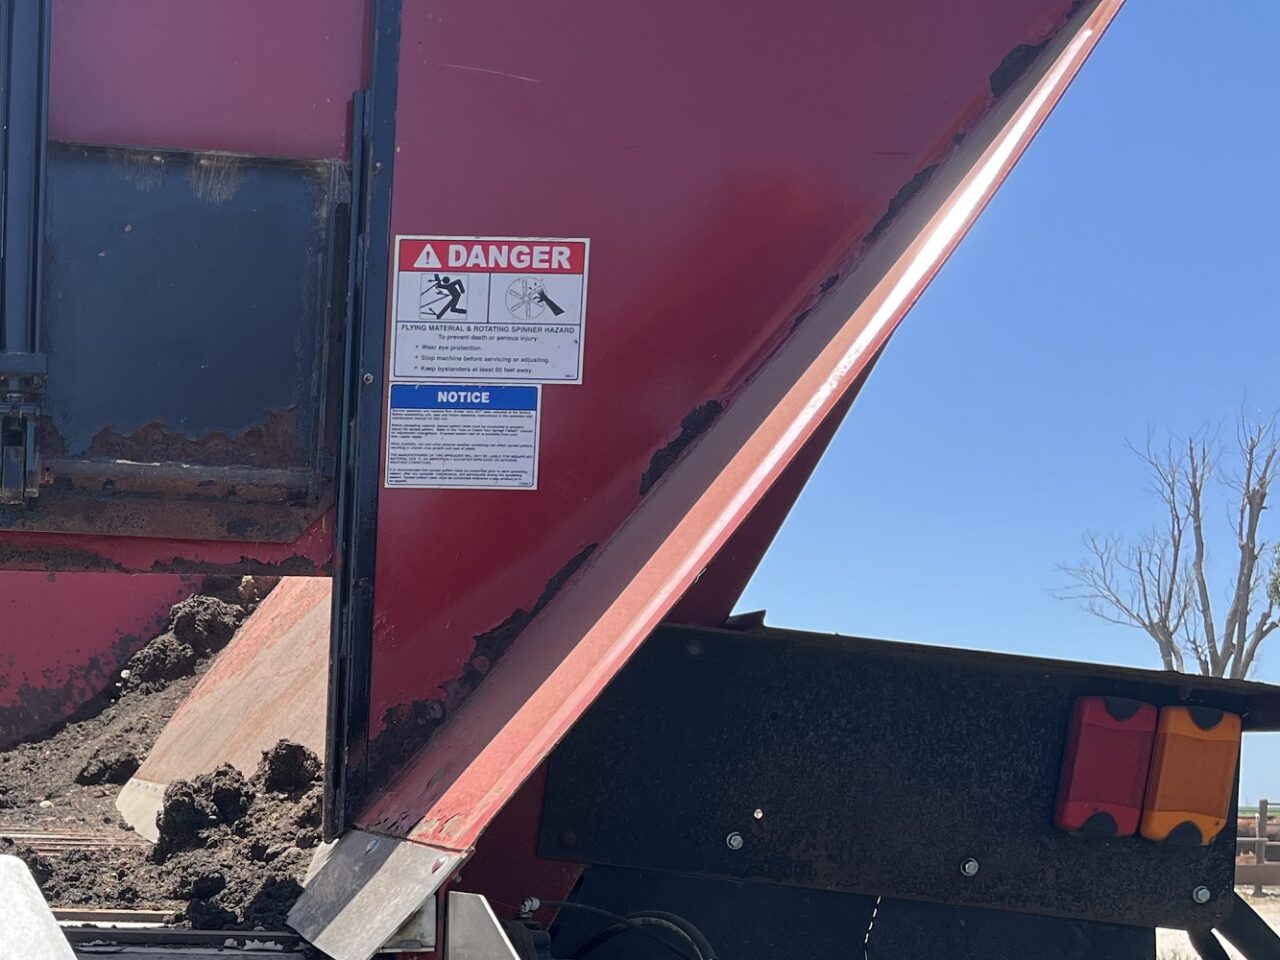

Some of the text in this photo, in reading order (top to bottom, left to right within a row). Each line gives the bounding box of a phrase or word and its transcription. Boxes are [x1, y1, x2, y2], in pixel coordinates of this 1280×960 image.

[448, 244, 571, 269] DANGER
[484, 356, 511, 364] servicing
[437, 391, 490, 404] NOTICE
